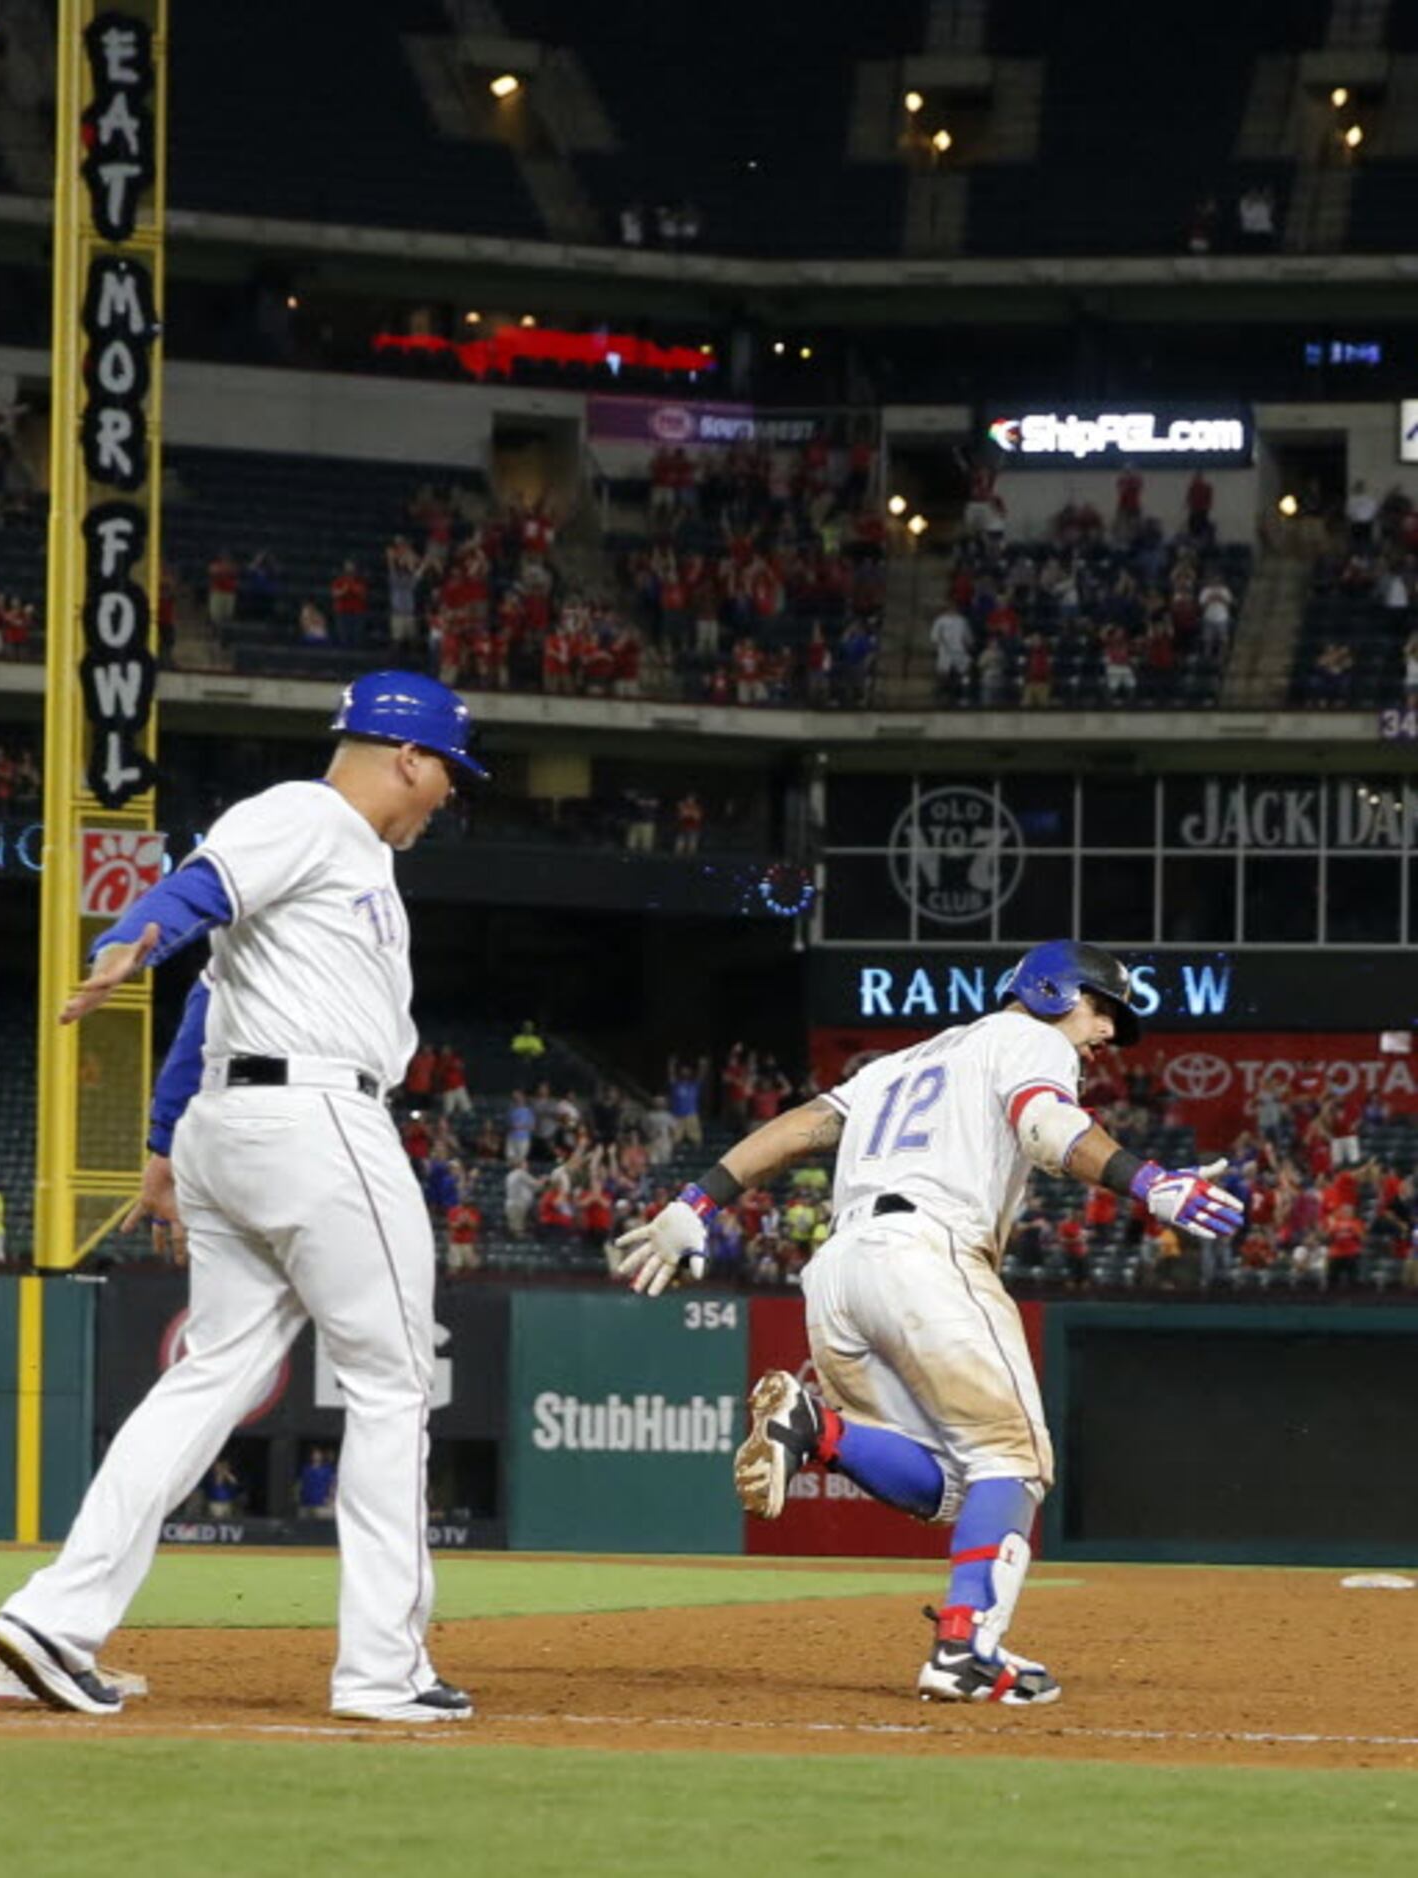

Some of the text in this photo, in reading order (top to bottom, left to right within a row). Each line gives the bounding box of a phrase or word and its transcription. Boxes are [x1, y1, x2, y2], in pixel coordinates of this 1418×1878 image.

[93, 26, 145, 793] EAT MOR FOWL
[929, 798, 983, 820] OLD
[1181, 781, 1317, 846] JACK
[927, 890, 983, 912] CLUB
[860, 1062, 946, 1161] 12
[684, 1302, 737, 1330] 354
[532, 1391, 735, 1452] StubHub!
